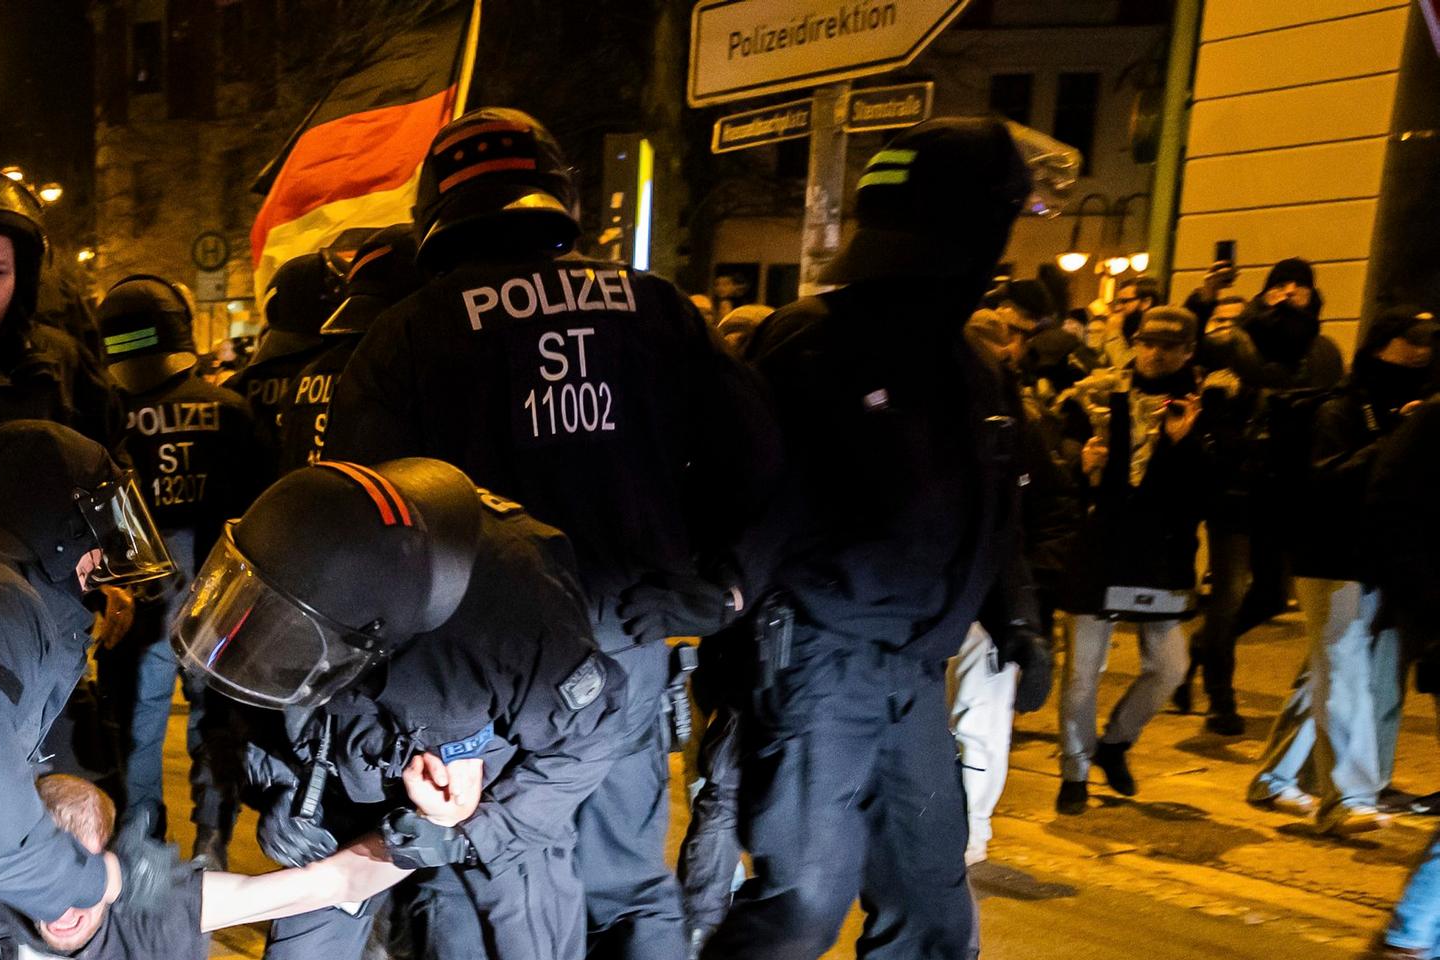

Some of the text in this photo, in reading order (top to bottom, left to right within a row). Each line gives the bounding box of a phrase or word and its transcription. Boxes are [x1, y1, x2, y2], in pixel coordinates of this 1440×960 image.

[727, 2, 896, 60] Polizeidirektion
[462, 268, 637, 331] POLIZEI
[538, 327, 595, 382] ST
[295, 374, 332, 404] POL
[524, 381, 616, 437] 11002
[159, 441, 194, 474] ST
